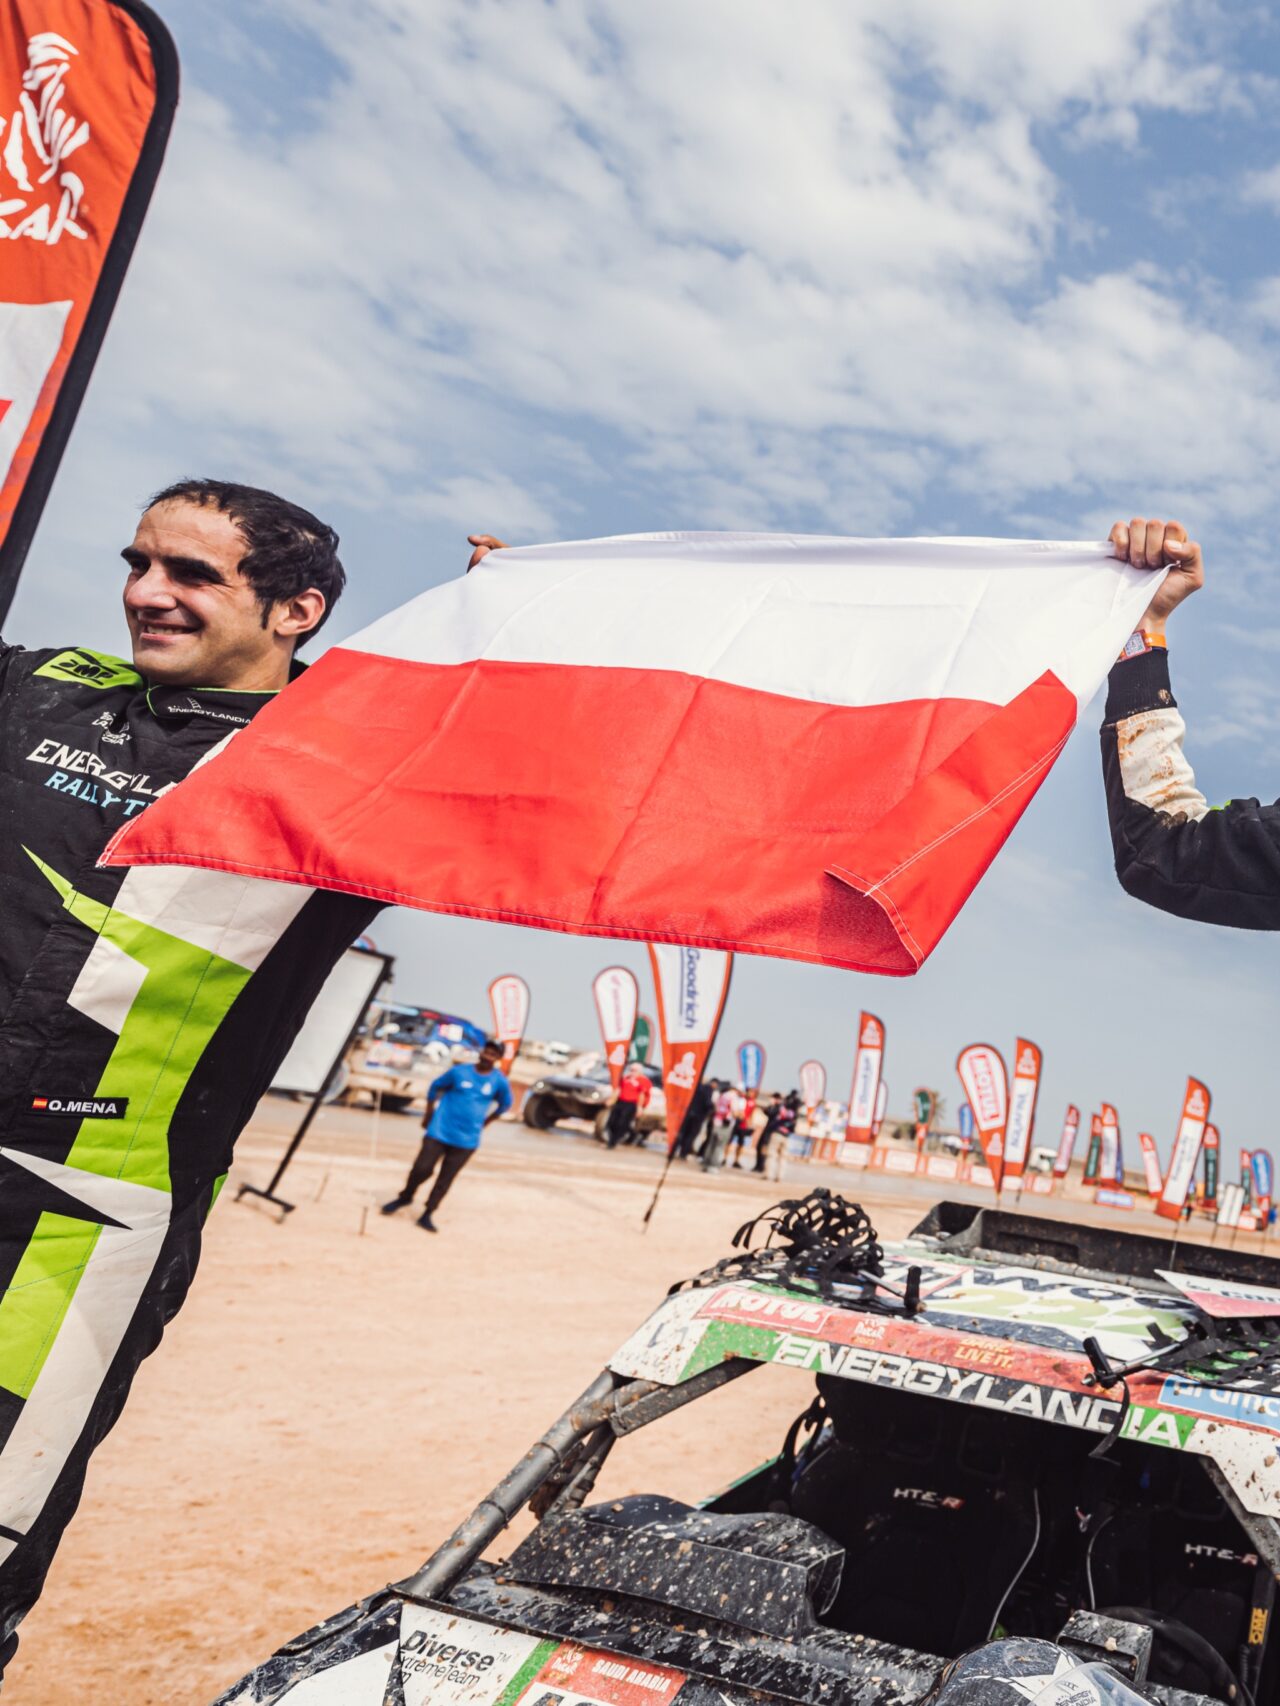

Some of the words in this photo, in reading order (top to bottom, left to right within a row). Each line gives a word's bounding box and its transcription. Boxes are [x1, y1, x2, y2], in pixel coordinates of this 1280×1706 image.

[168, 706, 251, 724] ENERGYLANDIA
[44, 771, 122, 810] RALLY
[48, 1099, 117, 1114] O.MENA
[711, 1291, 820, 1324] MOTUL
[954, 1346, 994, 1365] LIVE
[774, 1334, 1185, 1448] ENERGYLANDIA
[400, 1630, 495, 1672] Diverse
[591, 1659, 631, 1681] SAUDI
[626, 1668, 672, 1693] ARABIA
